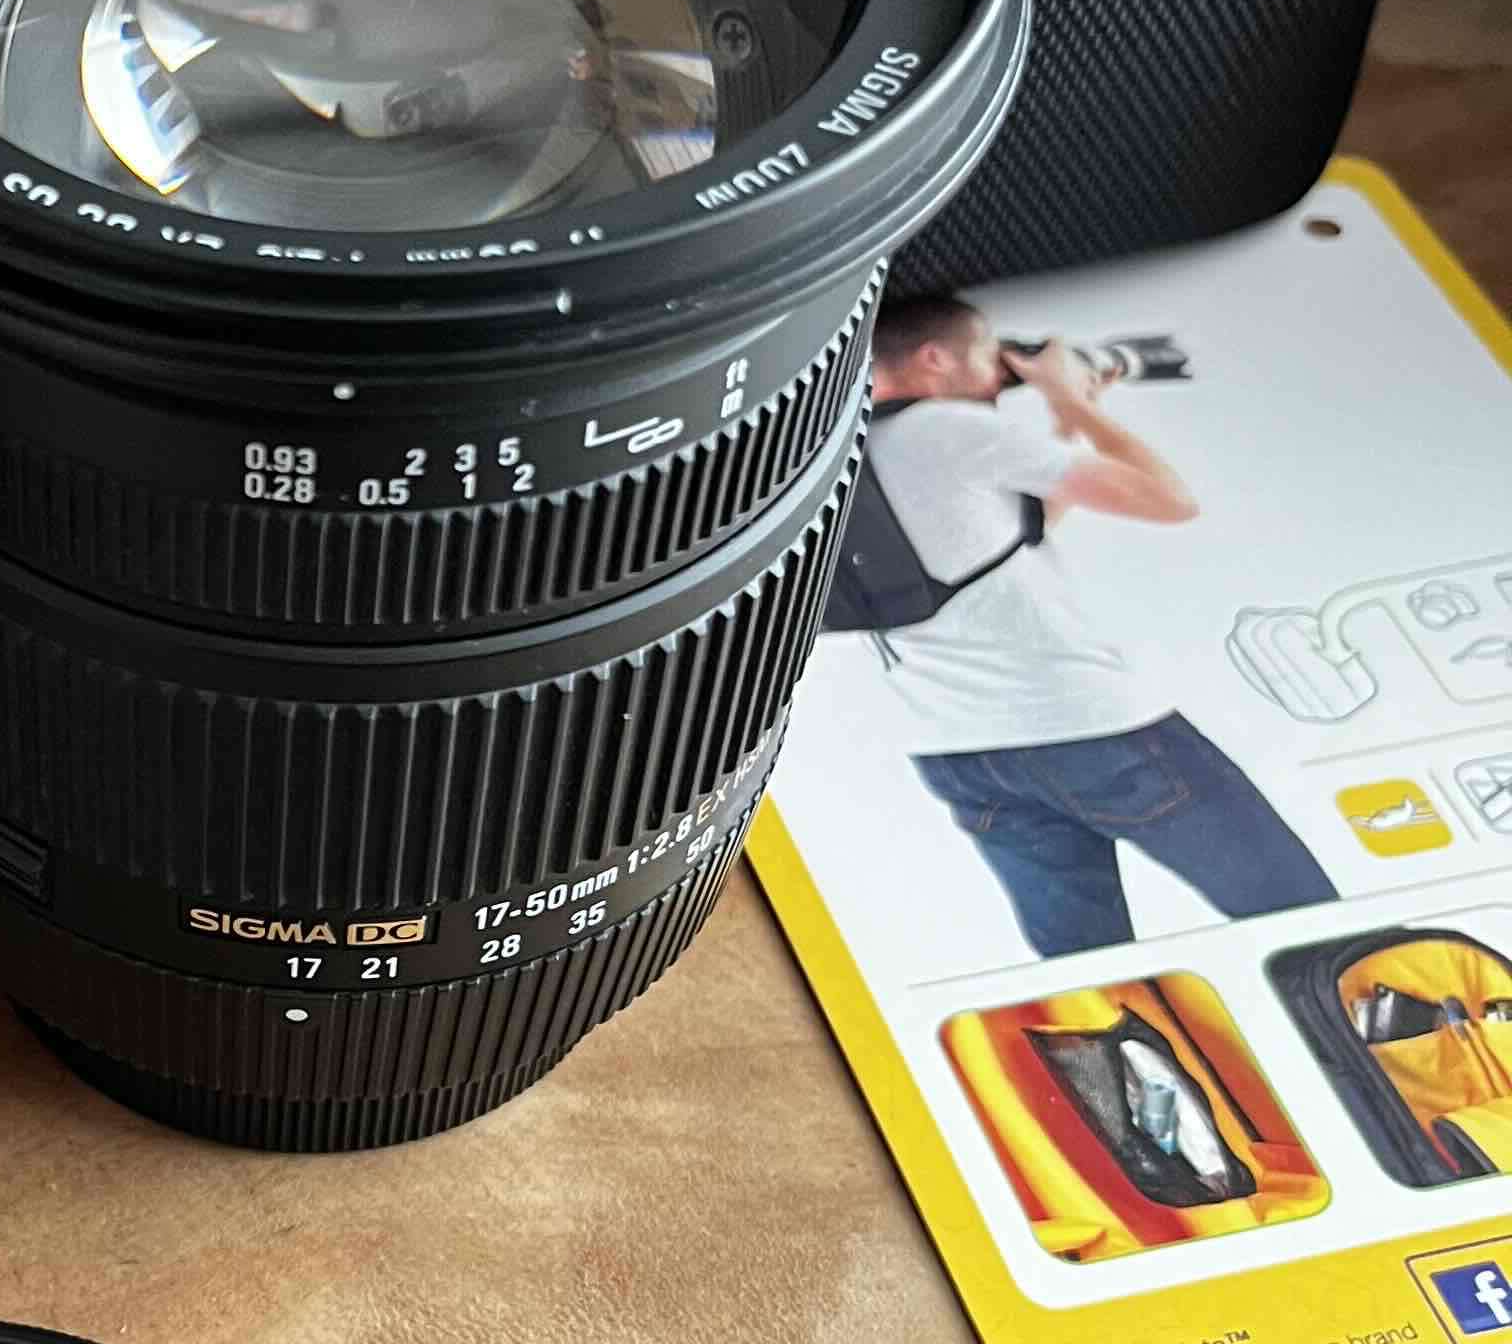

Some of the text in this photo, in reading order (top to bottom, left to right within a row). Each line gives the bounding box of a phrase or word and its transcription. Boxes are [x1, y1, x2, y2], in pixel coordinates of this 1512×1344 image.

[816, 46, 921, 137] SIGMA
[244, 442, 317, 474] 0.93
[404, 448, 427, 476] 2
[453, 443, 477, 472] 3
[498, 437, 521, 466] 5
[244, 472, 316, 504] 0.28
[358, 478, 410, 505] 0.5
[461, 473, 476, 499] 1
[512, 463, 536, 492] 2
[189, 908, 337, 945] SIGMA
[351, 919, 423, 944] DC
[626, 814, 692, 874] 1:2.8
[696, 779, 730, 826] EX
[287, 825, 715, 979] 17 21 28 35 50
